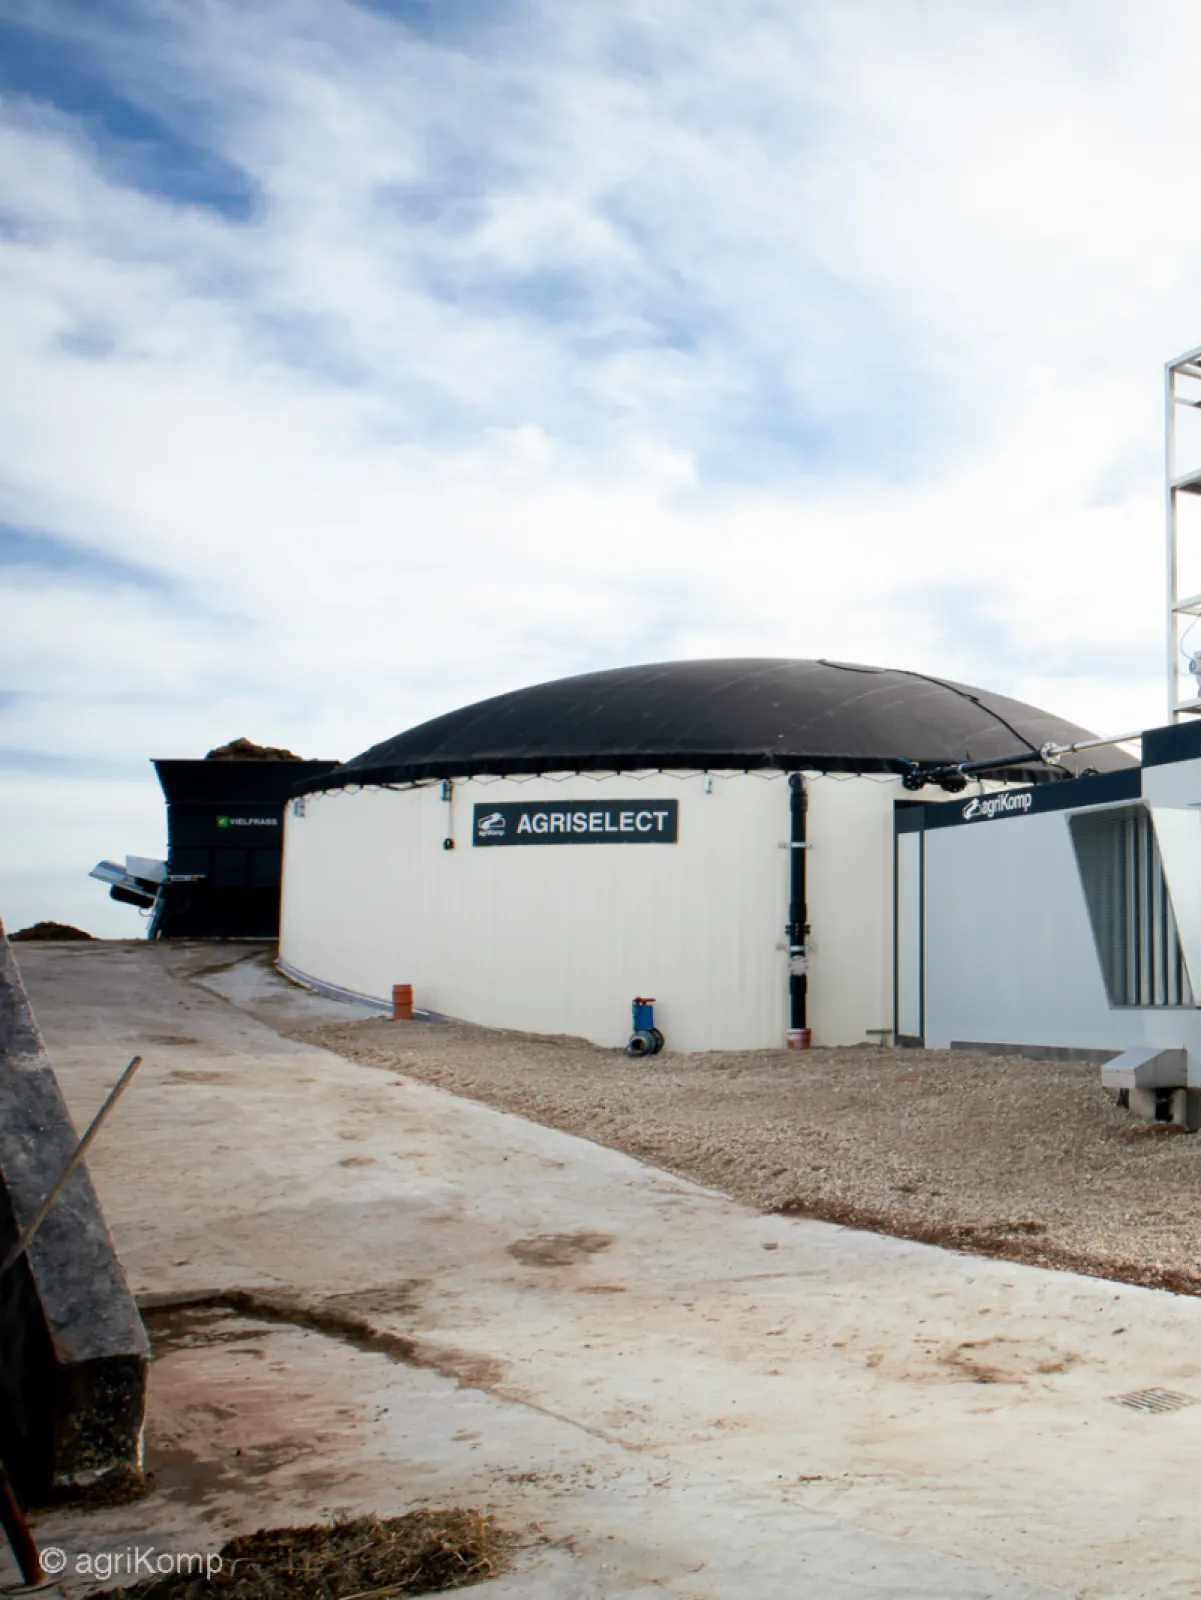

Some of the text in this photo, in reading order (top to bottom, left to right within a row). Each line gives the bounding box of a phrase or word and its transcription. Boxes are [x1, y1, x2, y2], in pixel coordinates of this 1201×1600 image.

[981, 792, 1032, 818] agriKomp
[230, 817, 278, 826] VIELFRASS
[516, 811, 669, 834] AGRISELECT
